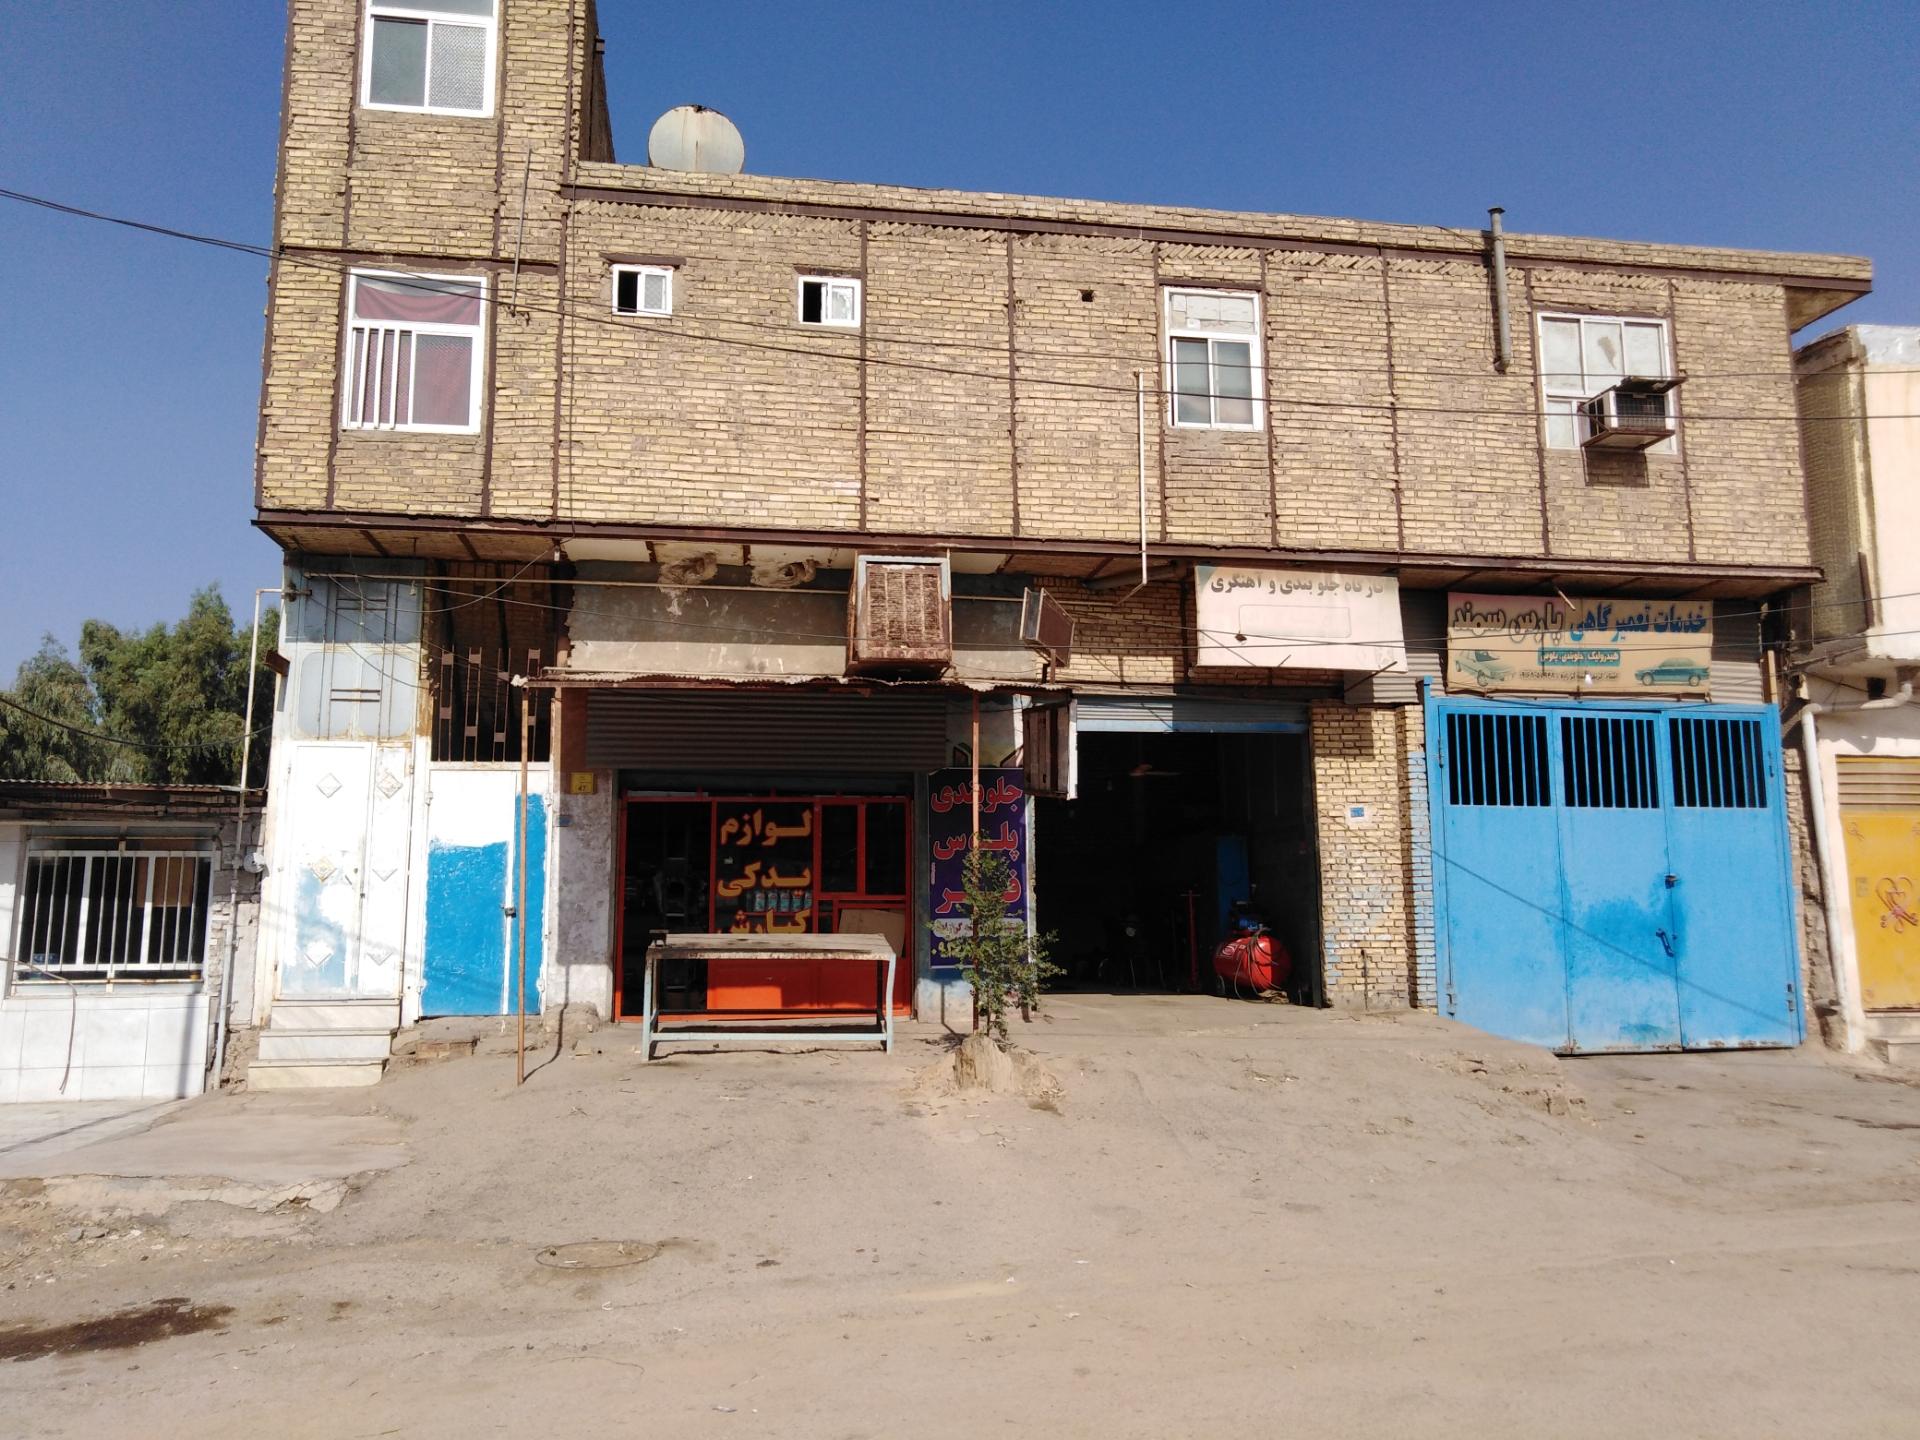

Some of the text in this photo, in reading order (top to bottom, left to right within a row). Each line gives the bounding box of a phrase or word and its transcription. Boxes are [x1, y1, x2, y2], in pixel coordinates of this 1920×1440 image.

[1453, 601, 1507, 637] سمند
[1508, 602, 1564, 646] پارس
[1653, 604, 1707, 634] خدمات
[721, 808, 812, 846] لوازم
[717, 861, 811, 898] یدکی
